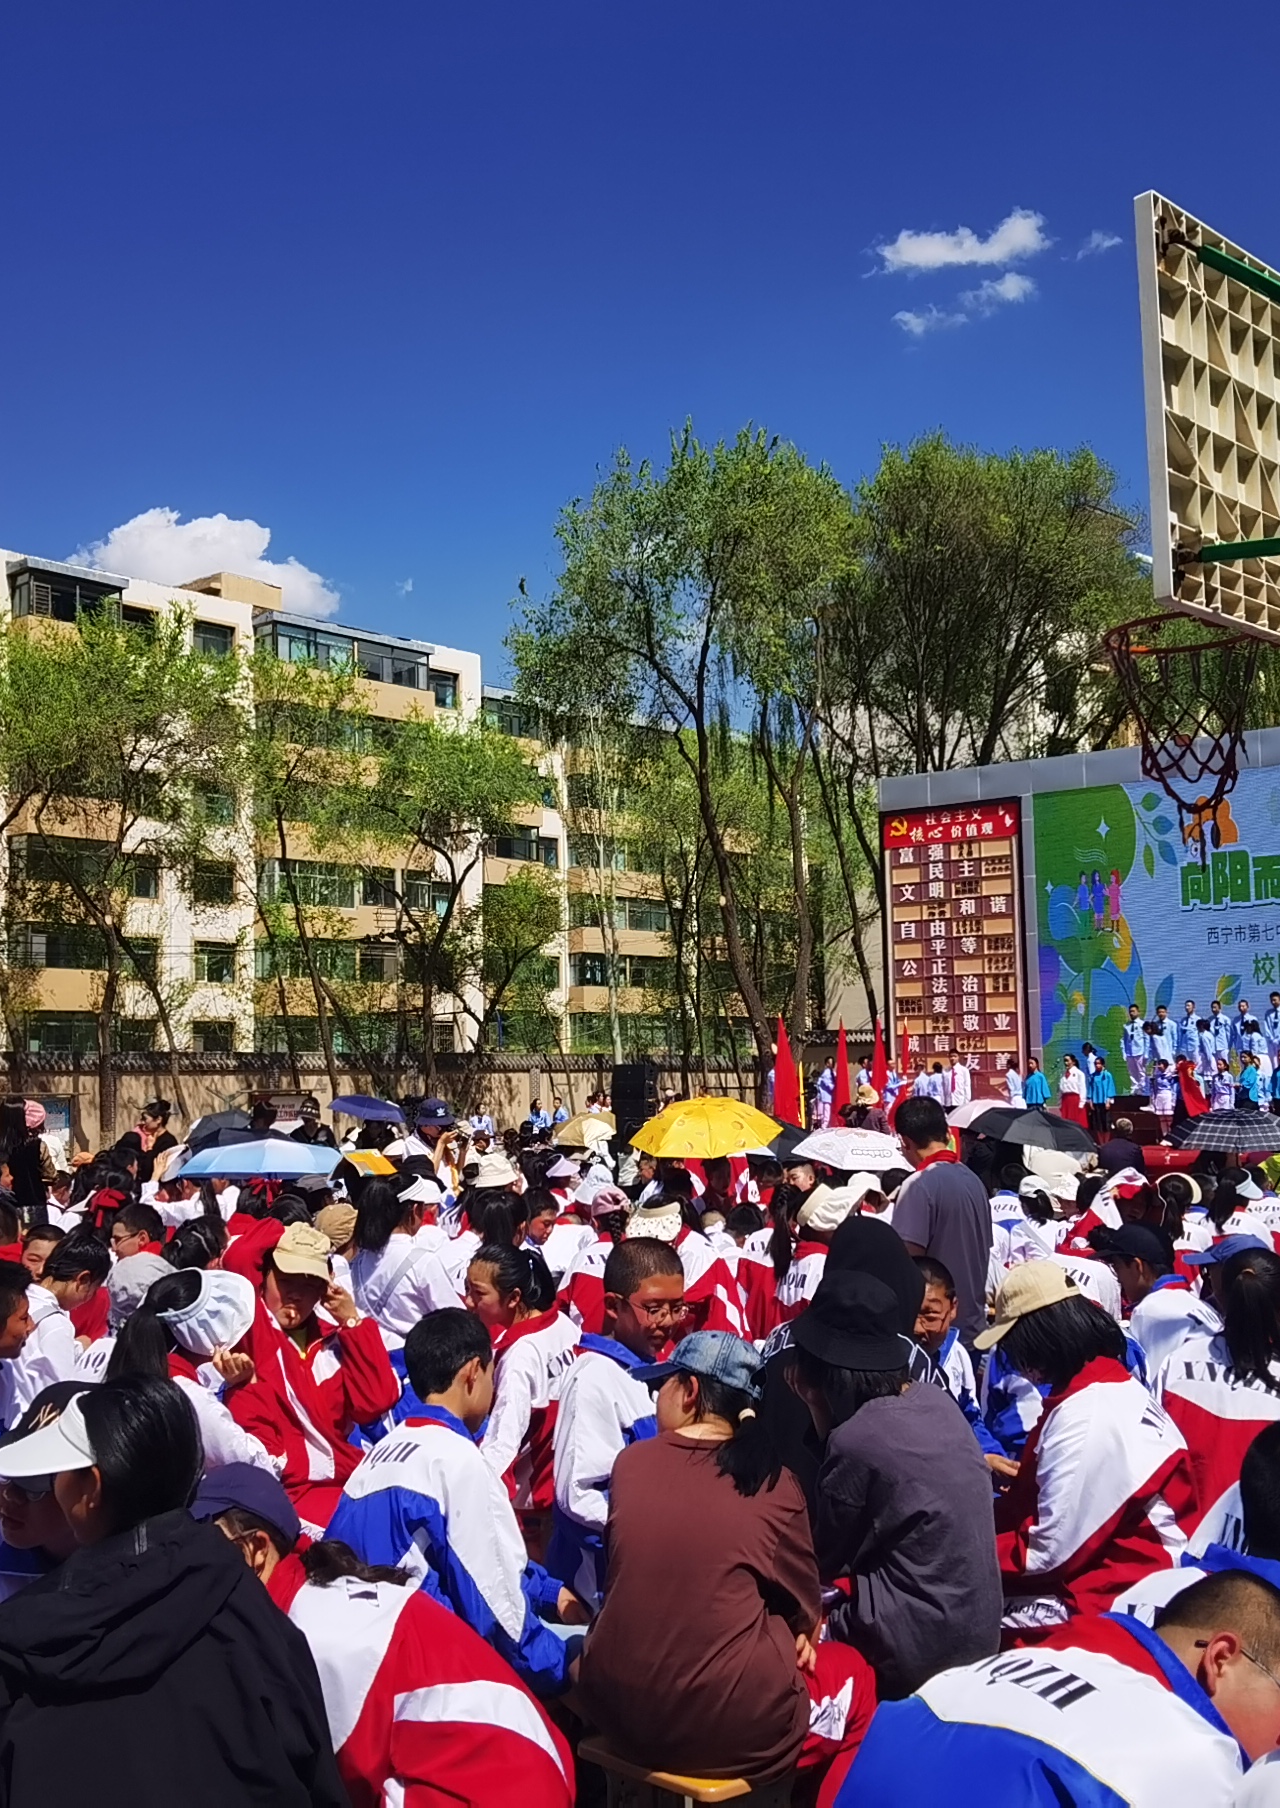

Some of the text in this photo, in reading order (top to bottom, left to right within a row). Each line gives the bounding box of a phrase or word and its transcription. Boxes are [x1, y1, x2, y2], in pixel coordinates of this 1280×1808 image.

[926, 809, 982, 825] 社会主义
[899, 844, 944, 864] 富强
[929, 861, 975, 879] 民主
[900, 881, 944, 901] 文明
[960, 896, 1006, 915] 和谐
[901, 920, 946, 939] 自由
[931, 937, 977, 955] 平等
[902, 958, 948, 976] 公正
[932, 975, 978, 994] 法治
[932, 996, 978, 1013] 爱国
[963, 1014, 1011, 1032] 敬业
[965, 1053, 1011, 1071] 友善
